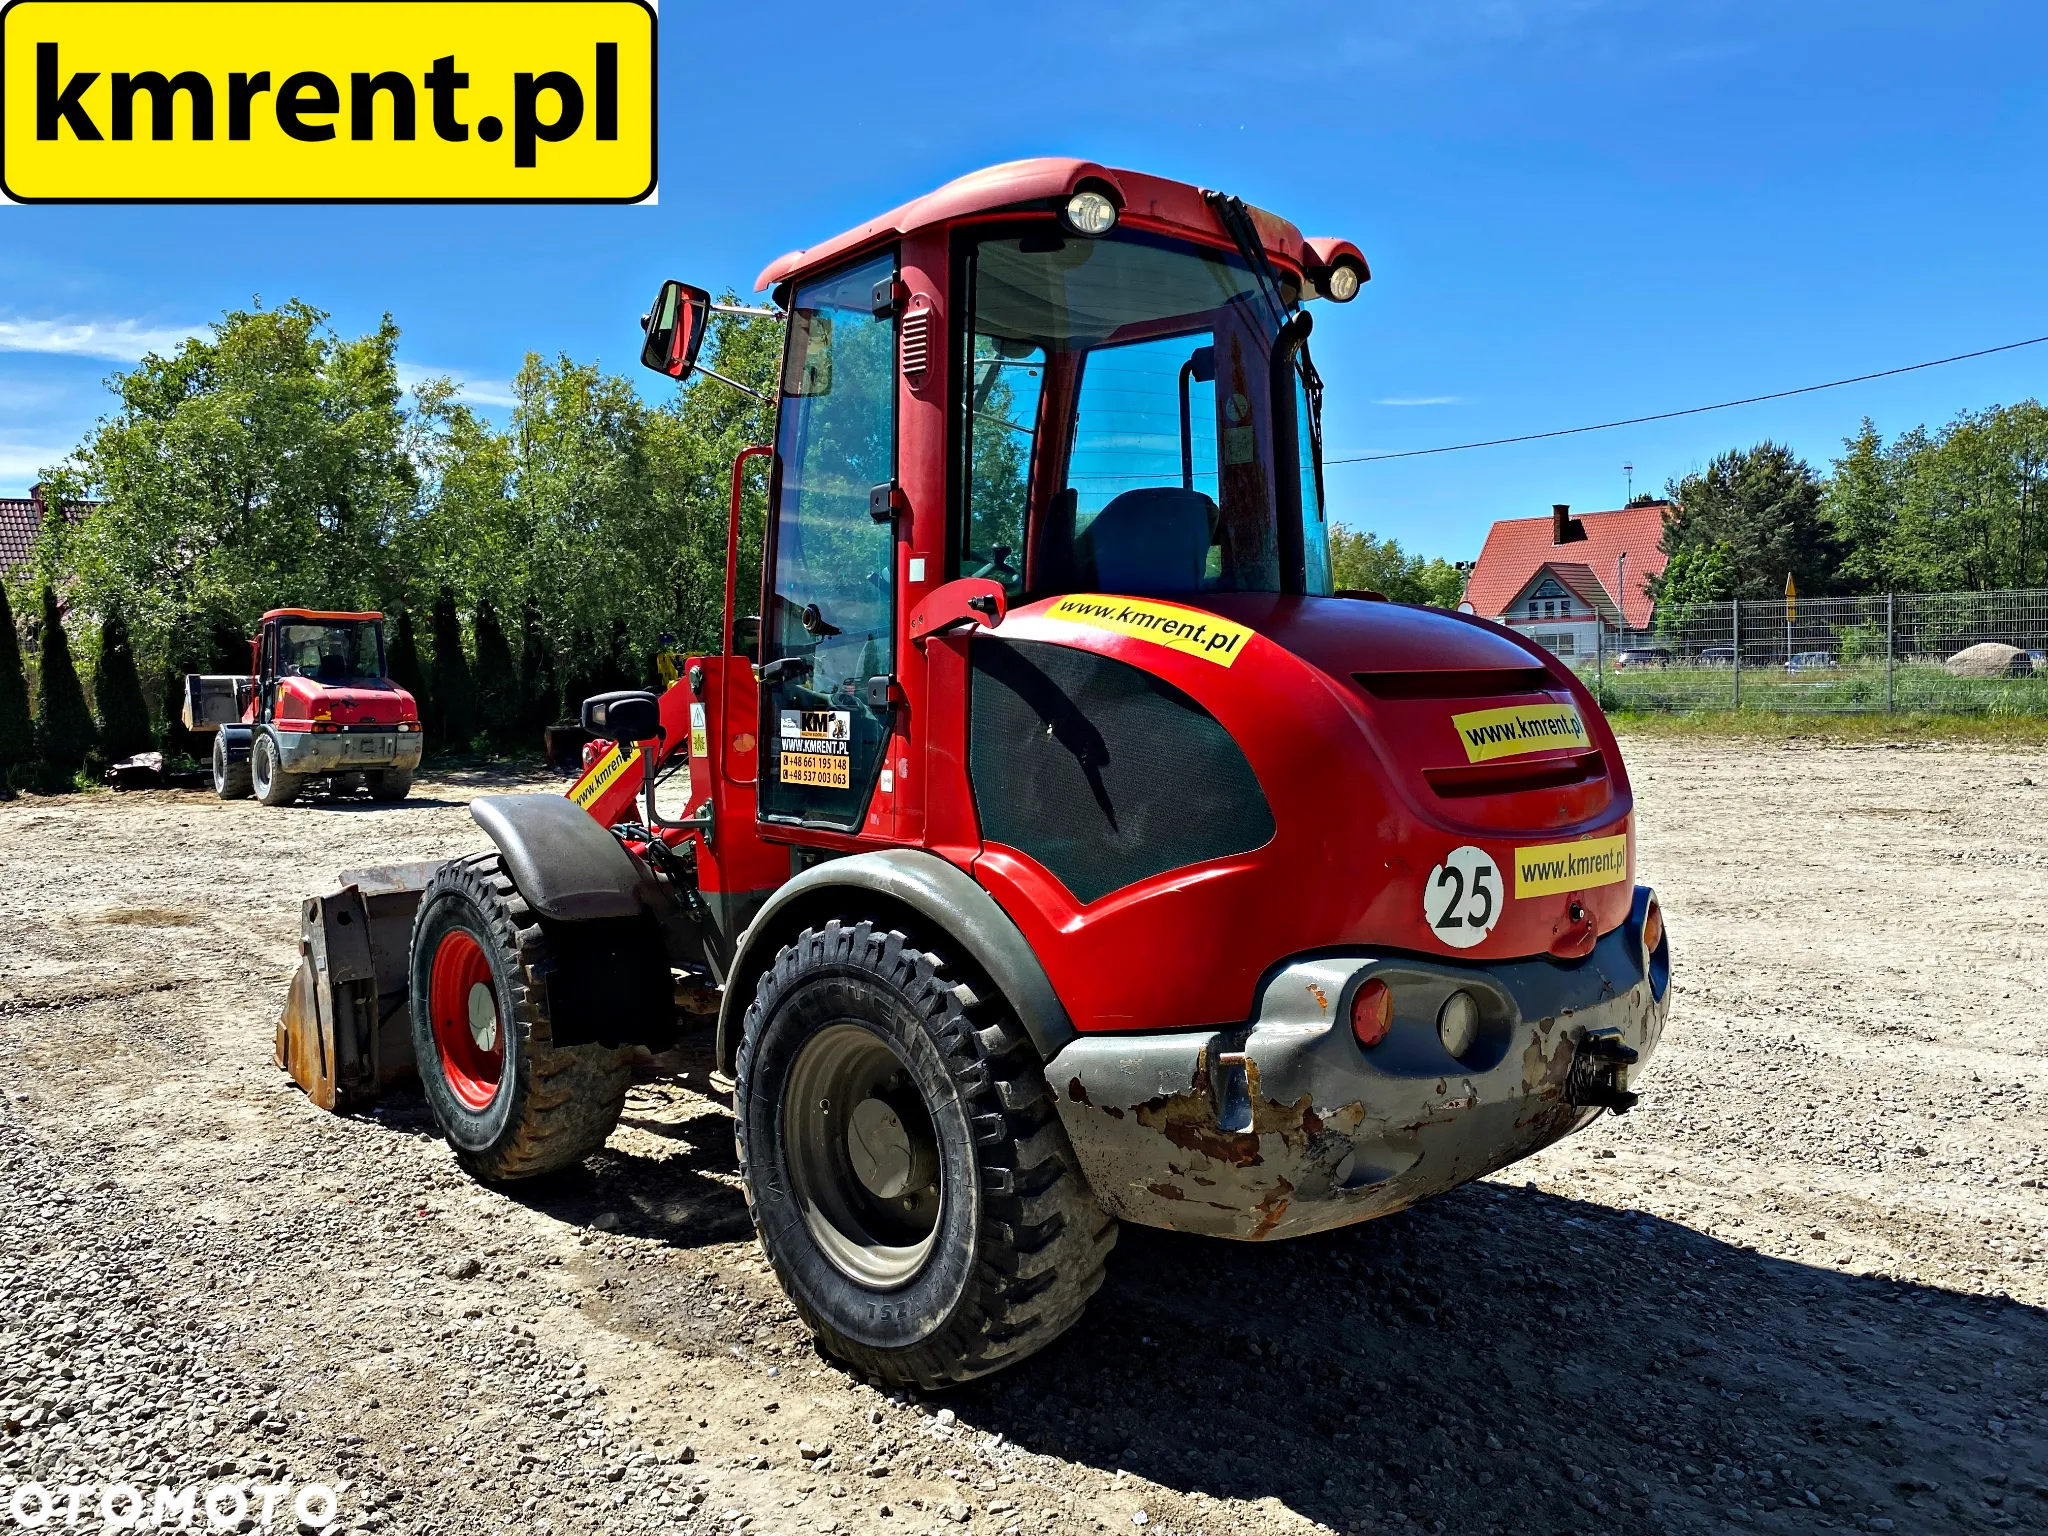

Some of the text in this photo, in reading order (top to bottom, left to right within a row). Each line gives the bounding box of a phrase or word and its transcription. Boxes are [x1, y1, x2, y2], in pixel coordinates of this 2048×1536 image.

[1059, 601, 1240, 653] www.kmrent.pl
[801, 712, 828, 732] KM
[1465, 714, 1583, 746] www.kmrent.pl
[781, 738, 849, 754] WWW.KMRENT.PL
[789, 755, 847, 770] +48 661 195 148
[789, 770, 846, 784] +48 537 003 063
[1521, 848, 1625, 882] www.kmrent.pl
[1435, 865, 1493, 929] 25
